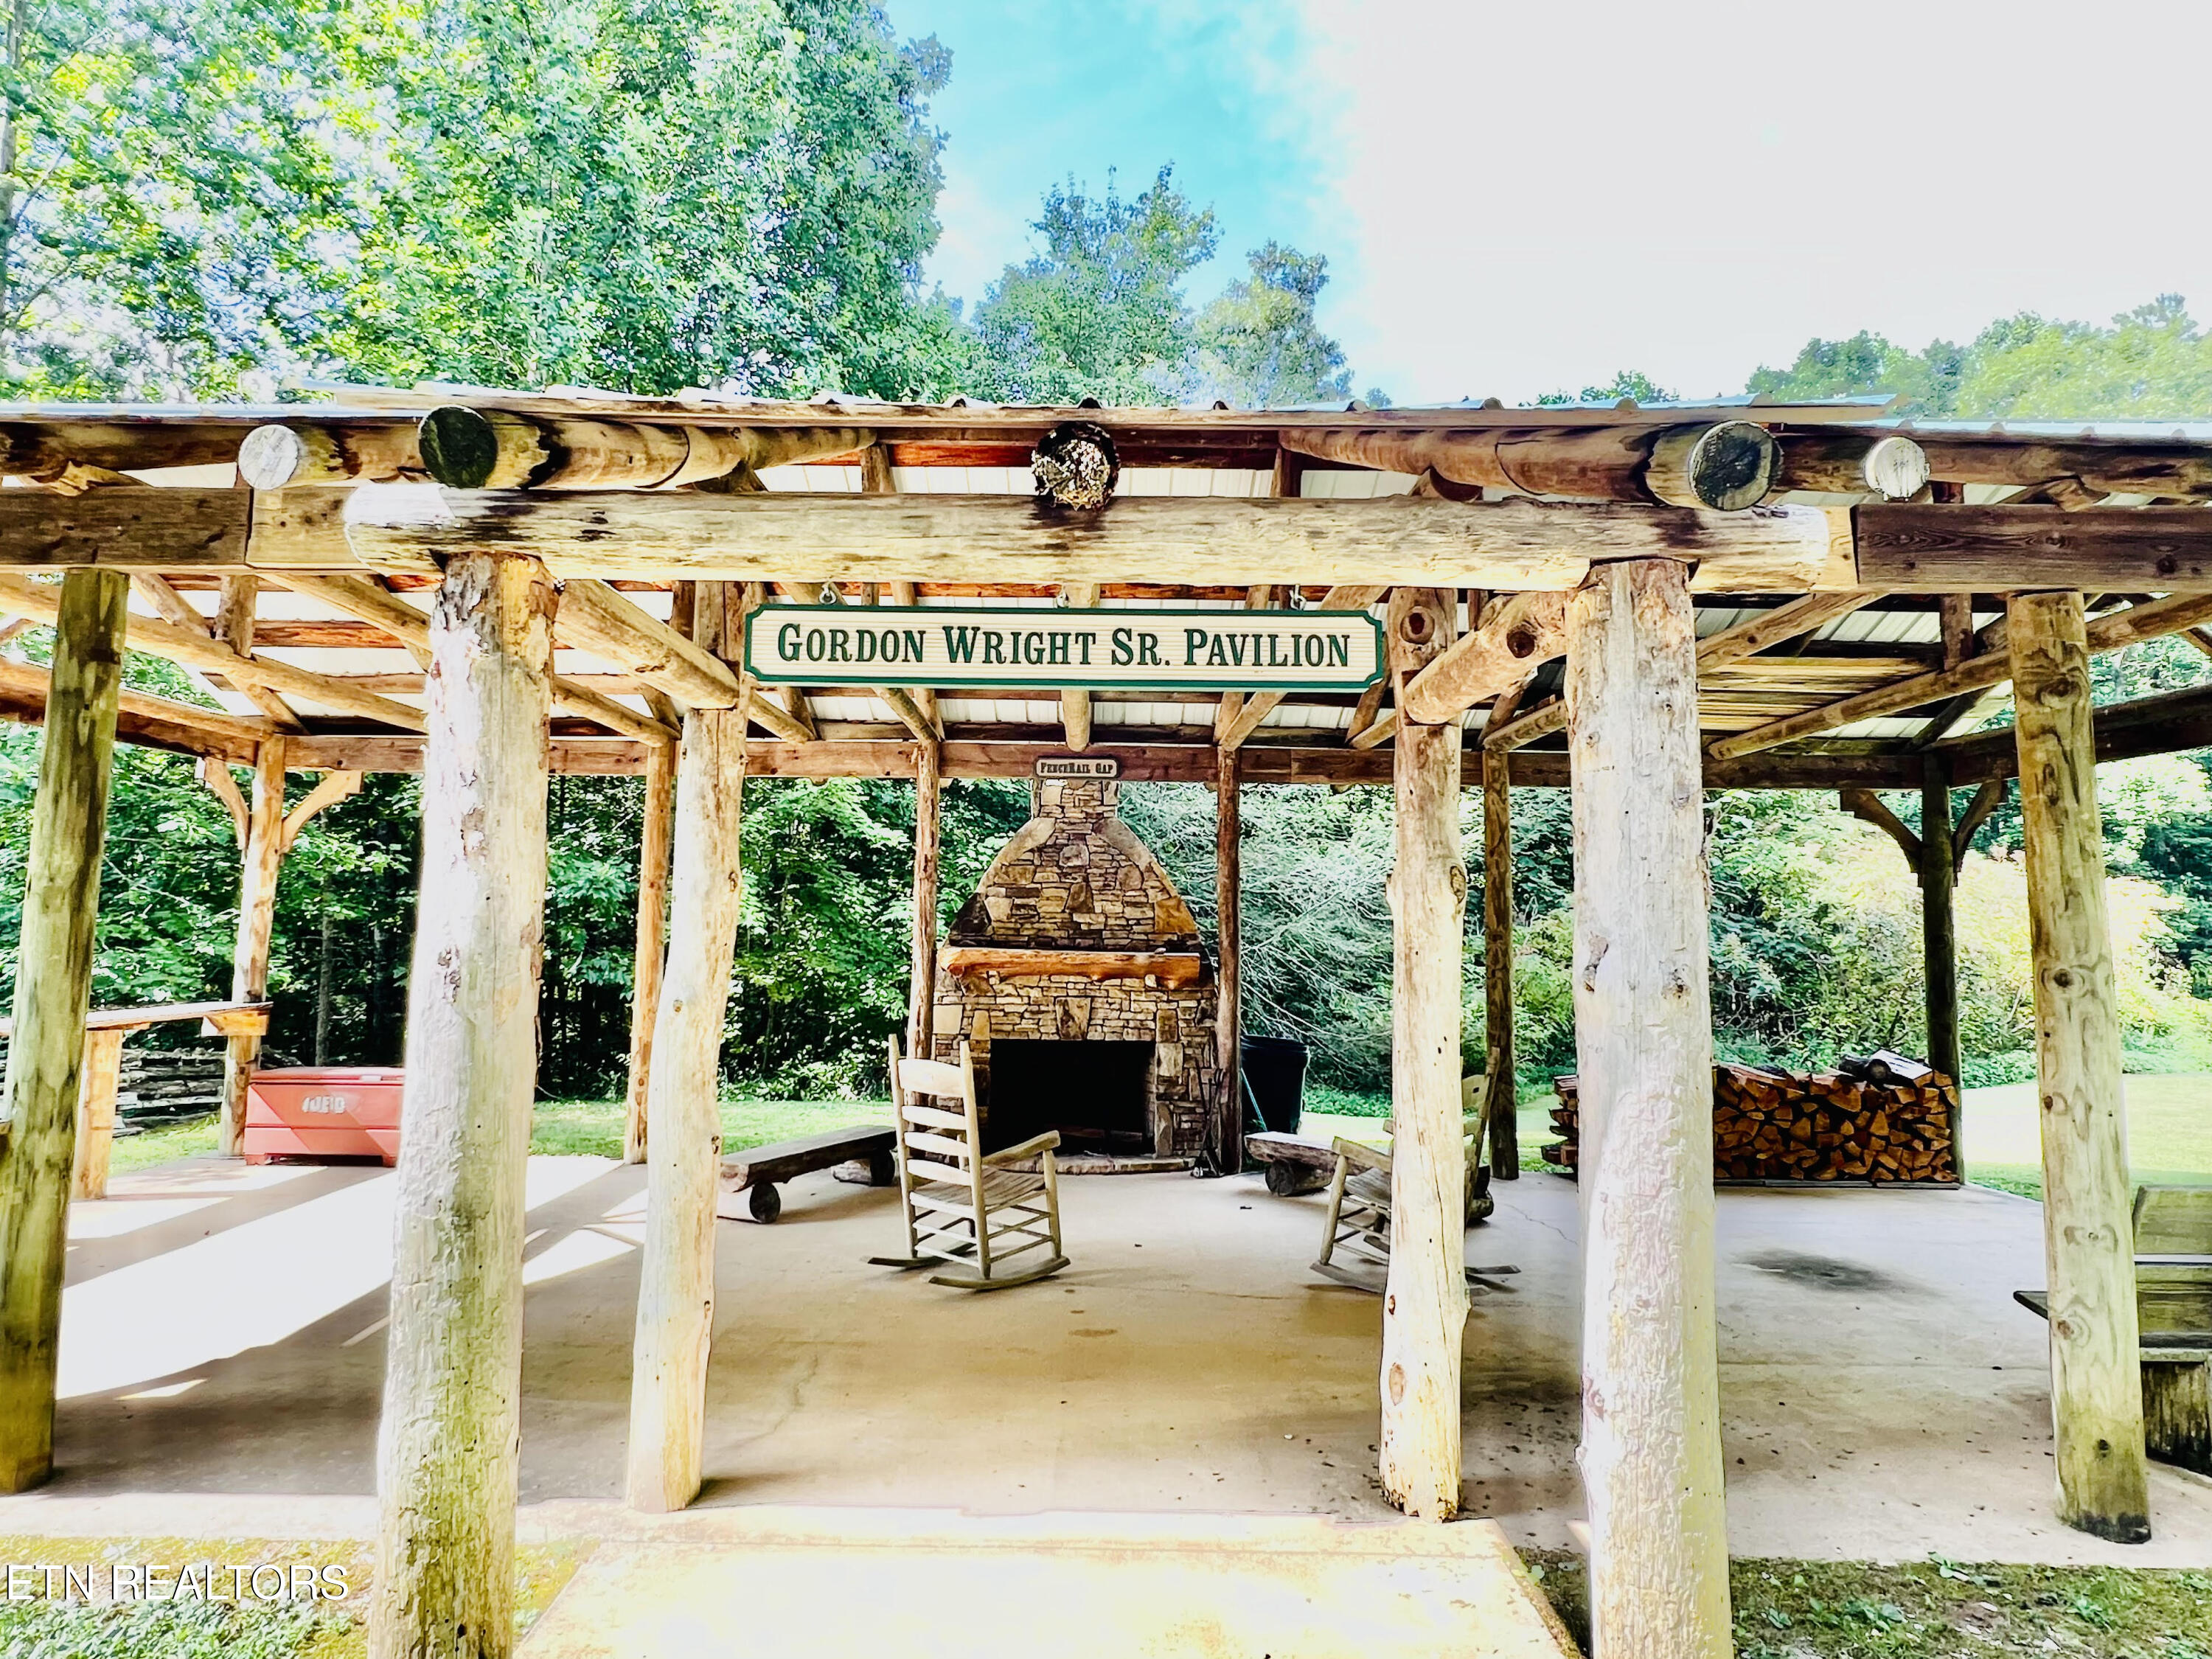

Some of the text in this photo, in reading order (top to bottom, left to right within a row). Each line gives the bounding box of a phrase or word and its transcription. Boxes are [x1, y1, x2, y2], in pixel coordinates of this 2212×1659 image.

[778, 623, 1350, 667] GORDON WRIGHT SR. PAVILION
[1095, 763, 1113, 774] GAP
